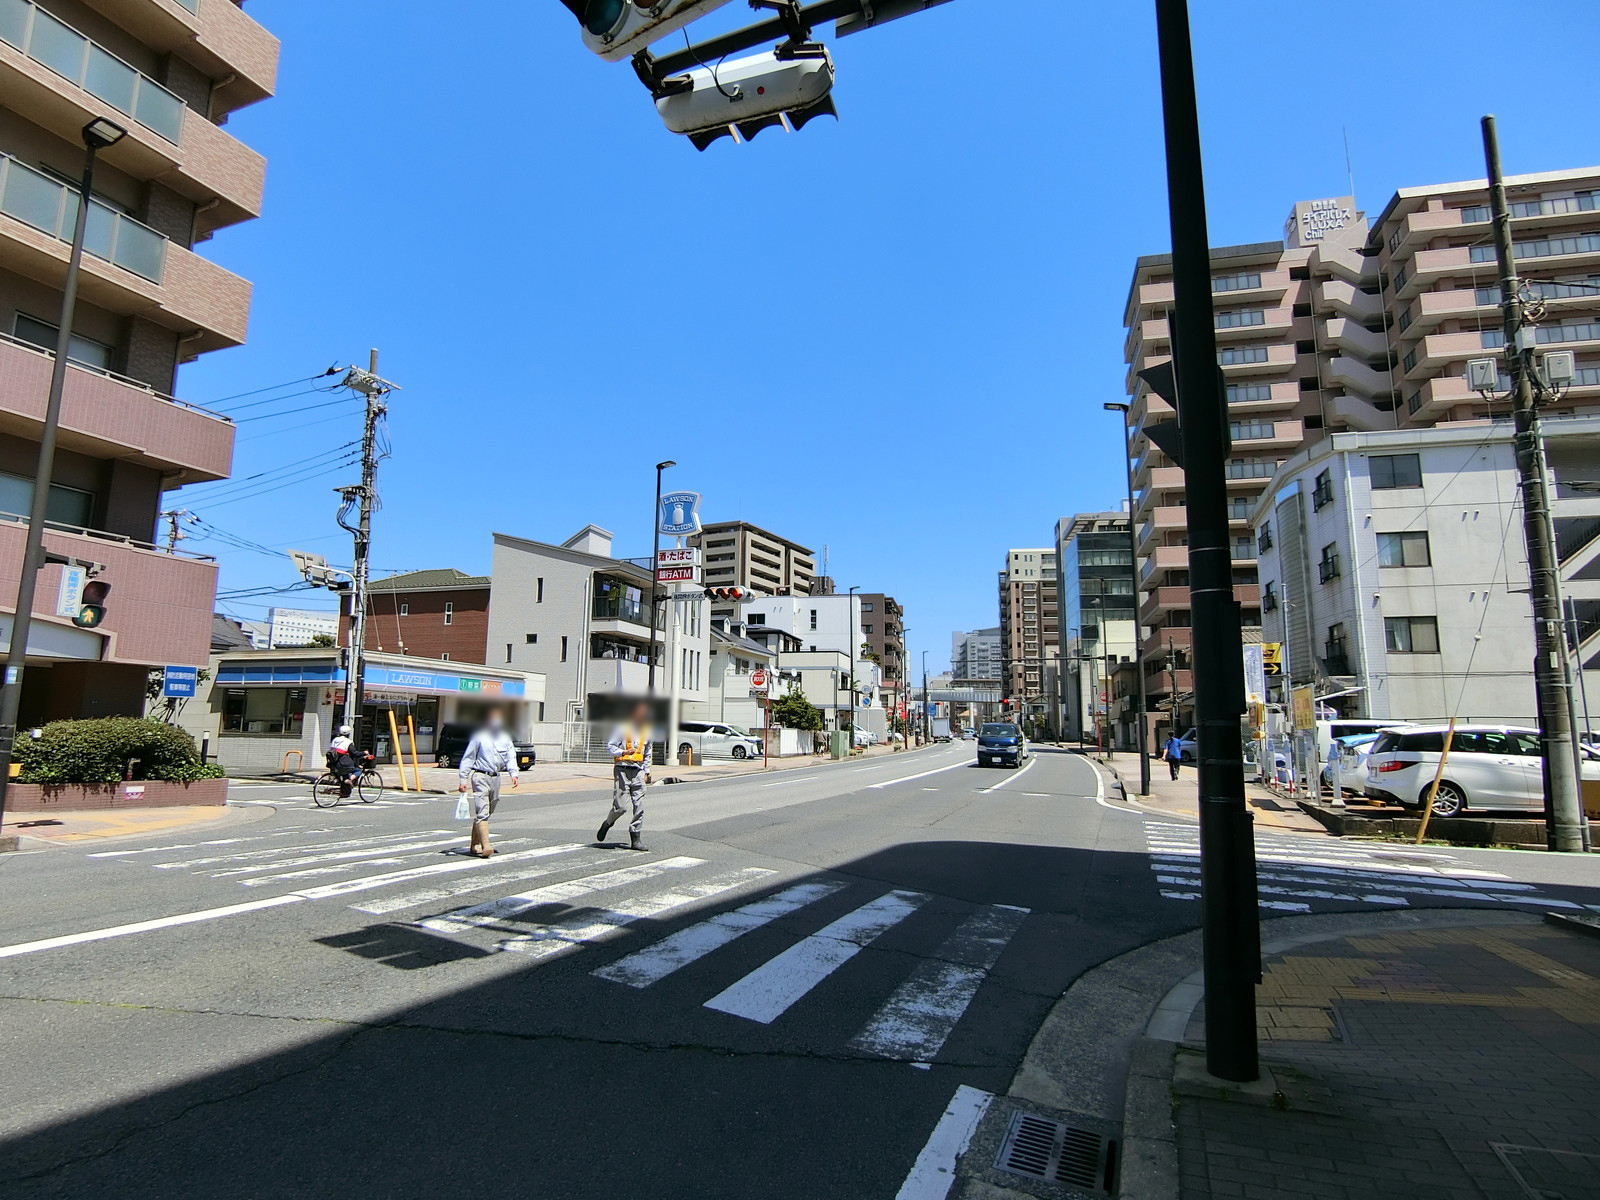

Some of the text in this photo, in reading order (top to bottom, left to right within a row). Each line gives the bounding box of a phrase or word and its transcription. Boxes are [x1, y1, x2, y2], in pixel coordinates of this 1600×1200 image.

[1302, 208, 1351, 224] ダイアパレス
[1310, 219, 1344, 230] LUXA
[664, 495, 694, 504] LAWSON
[663, 523, 694, 532] STATION
[391, 673, 433, 686] LAWSON
